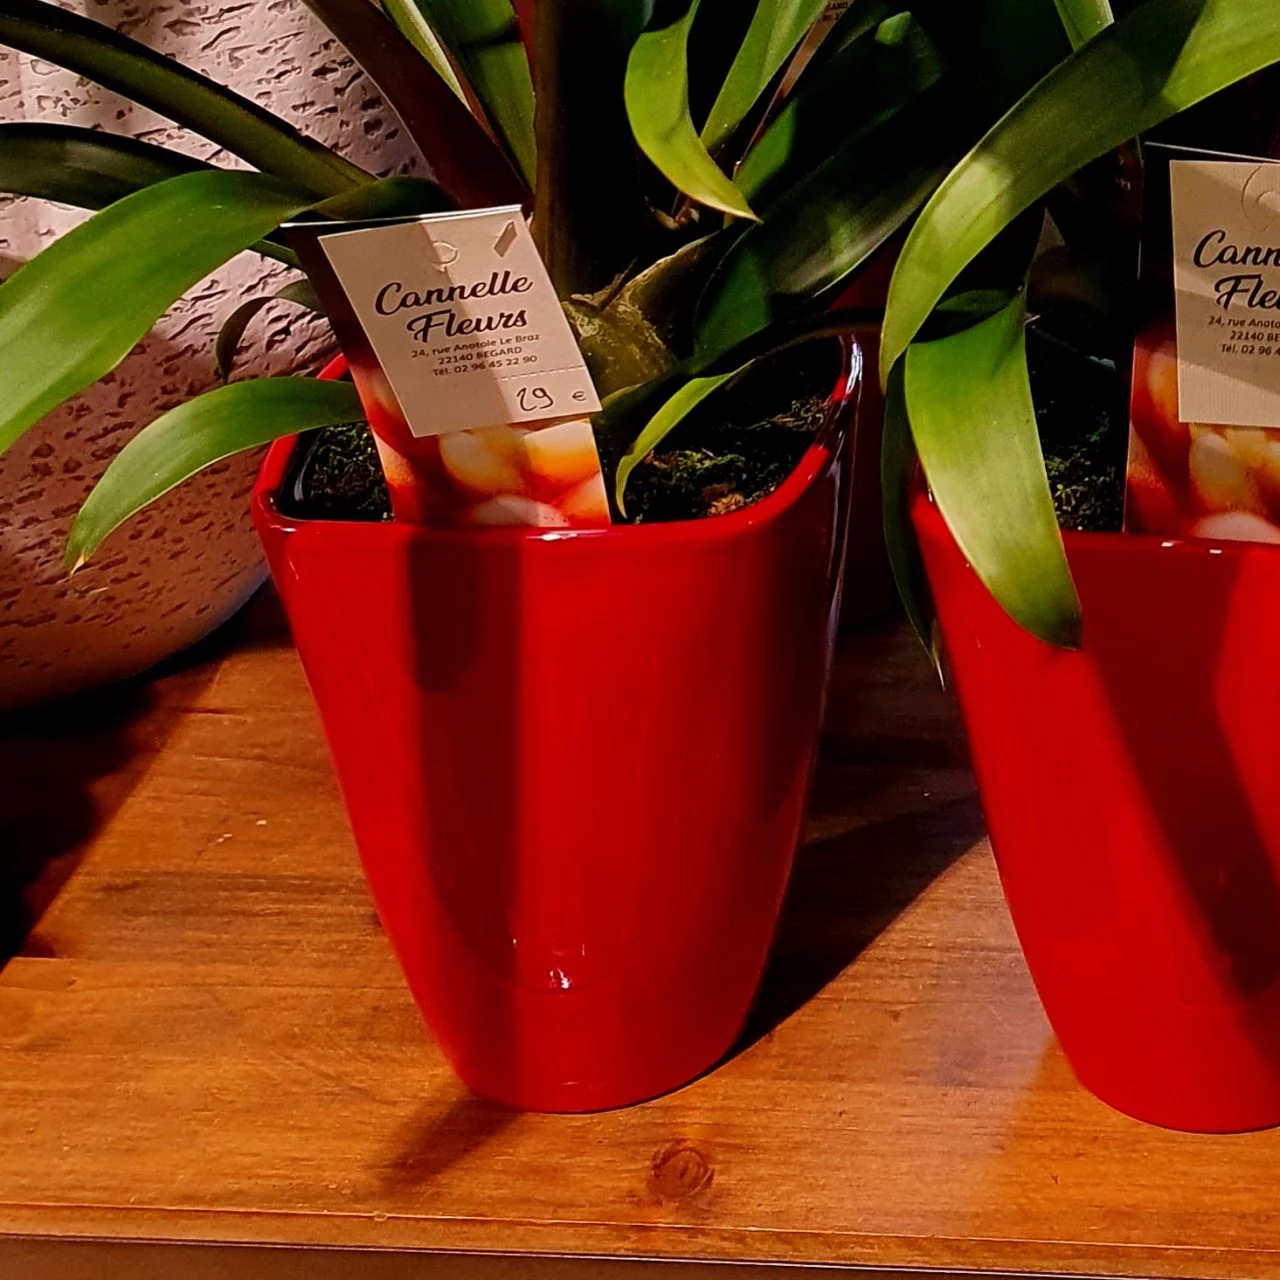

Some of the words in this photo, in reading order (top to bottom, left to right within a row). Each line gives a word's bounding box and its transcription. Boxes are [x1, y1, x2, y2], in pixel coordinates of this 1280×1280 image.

[375, 271, 533, 316] Cannelle
[406, 308, 528, 344] Fleurs
[1227, 318, 1246, 327] rue
[432, 346, 451, 356] rue
[454, 339, 496, 352] Anatole
[500, 337, 513, 346] Le
[515, 333, 540, 343] Braz
[1230, 330, 1264, 341] 22140
[438, 352, 473, 366] 22140
[476, 346, 523, 361] BEGARD
[1241, 344, 1255, 354] 02
[1258, 346, 1272, 355] 96
[454, 365, 469, 374] 02
[471, 362, 486, 371] 96
[488, 359, 503, 369] 45
[506, 357, 520, 366] 22
[522, 355, 537, 364] 90
[515, 387, 554, 412] 29
[571, 390, 588, 402] €
